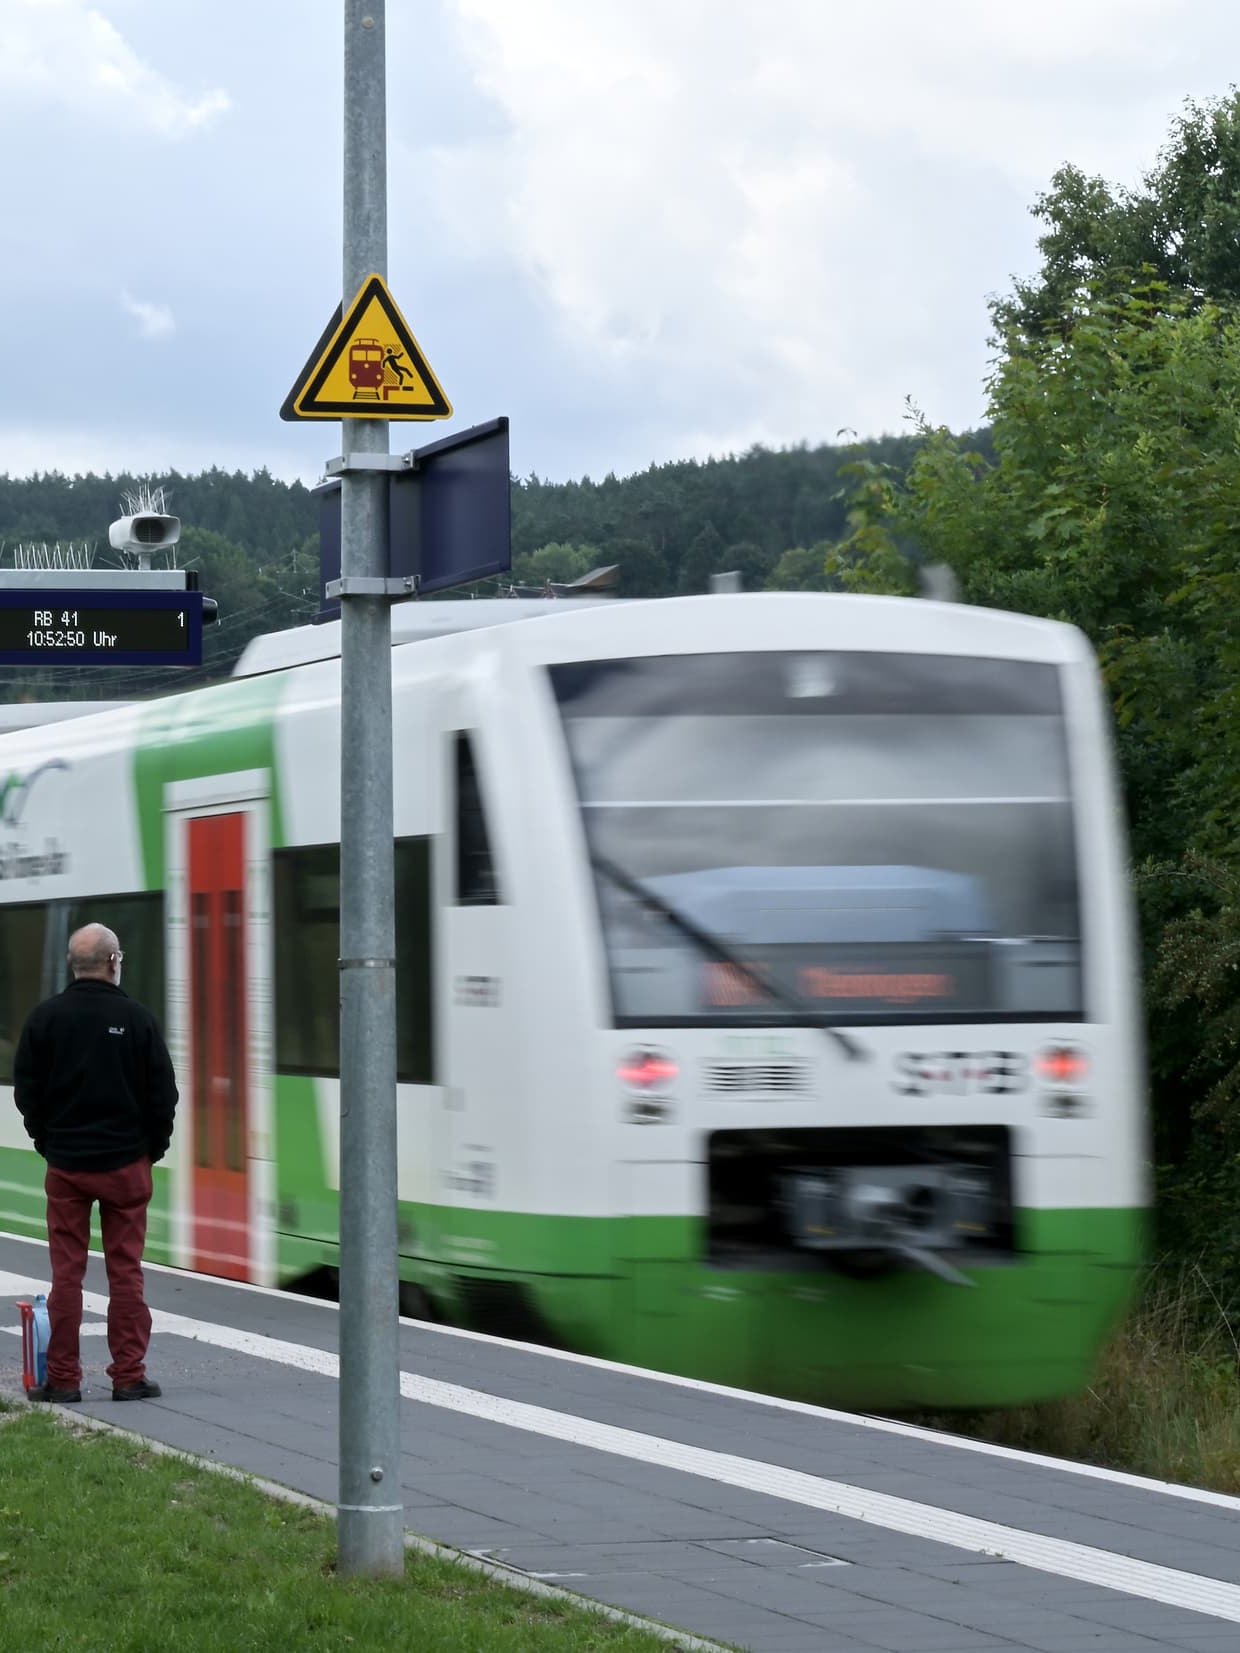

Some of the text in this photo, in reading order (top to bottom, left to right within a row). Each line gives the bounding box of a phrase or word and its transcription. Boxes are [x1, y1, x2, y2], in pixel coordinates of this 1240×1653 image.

[34, 610, 53, 627] RB
[61, 610, 78, 627] 41
[177, 611, 184, 627] 1
[26, 630, 118, 647] 10:52:50 Uhr
